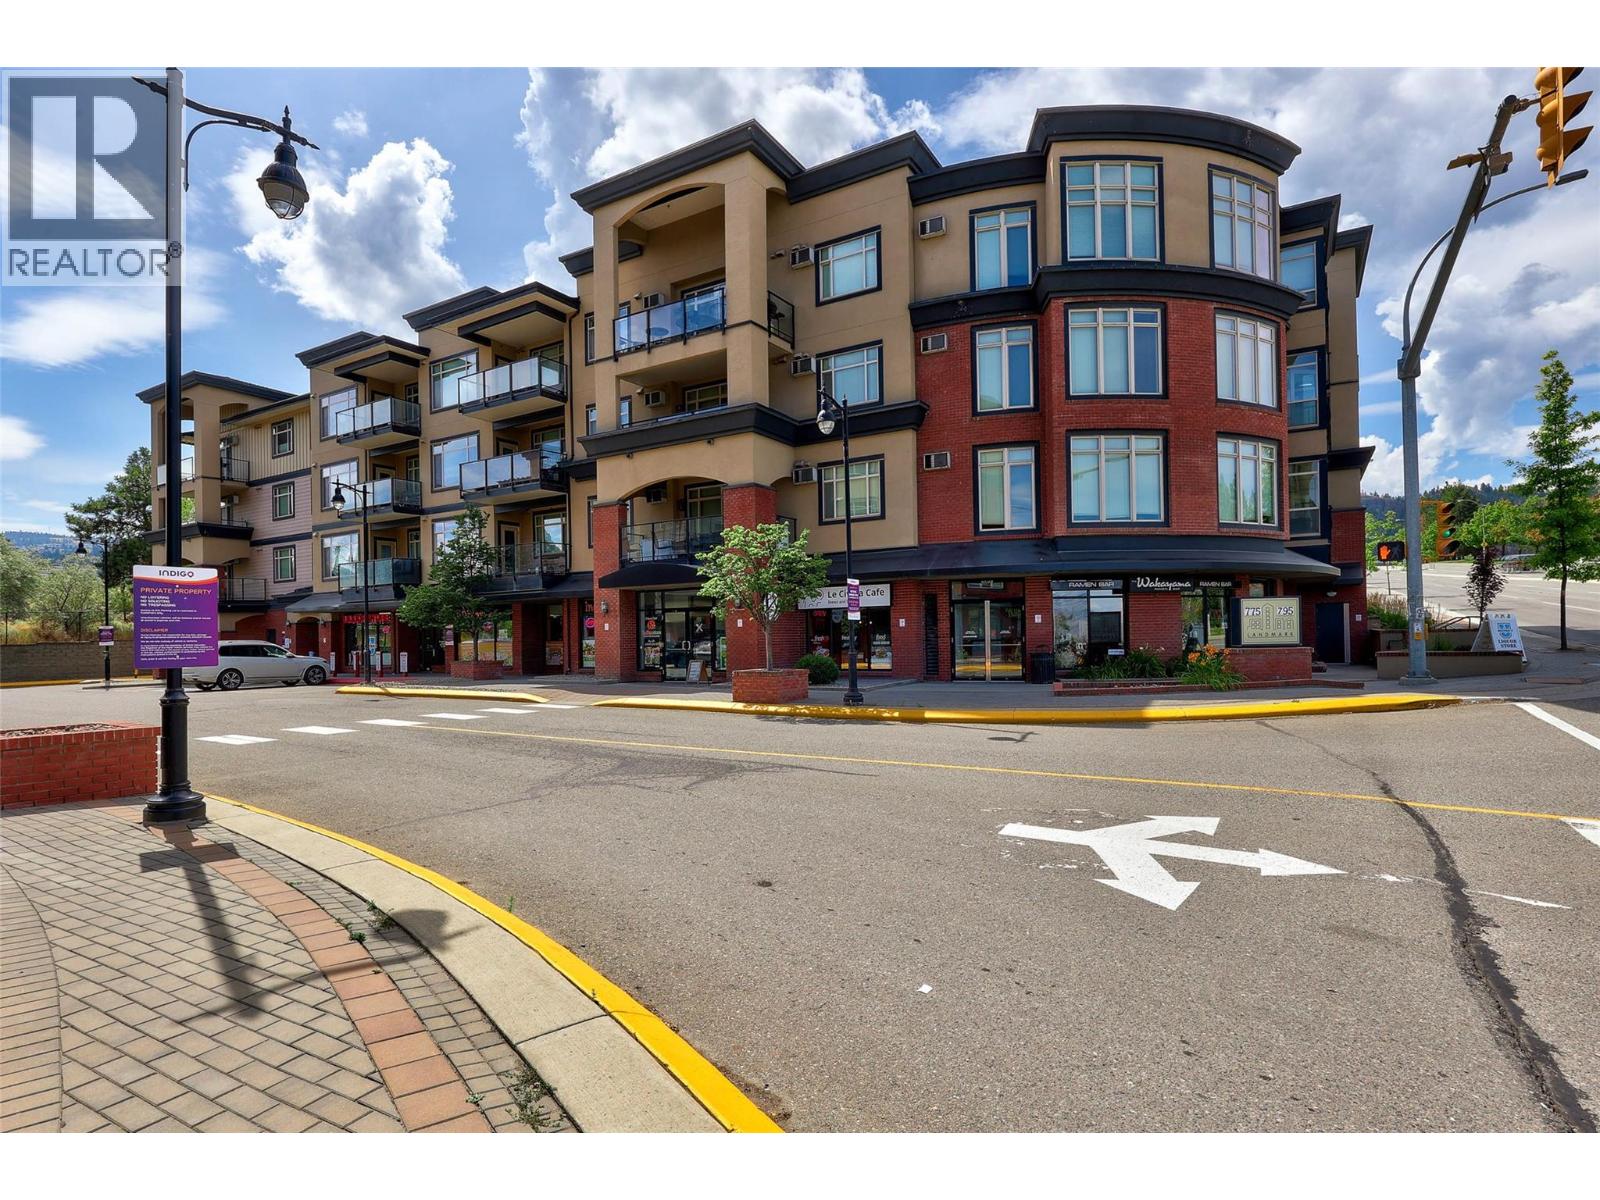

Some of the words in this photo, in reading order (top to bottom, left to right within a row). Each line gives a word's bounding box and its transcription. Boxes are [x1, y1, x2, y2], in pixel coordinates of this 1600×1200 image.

[158, 570, 194, 578] INDIGO
[1137, 576, 1191, 591] Wakayama
[865, 588, 885, 597] Cafe
[1245, 607, 1261, 616] 775
[1277, 606, 1294, 616] 795
